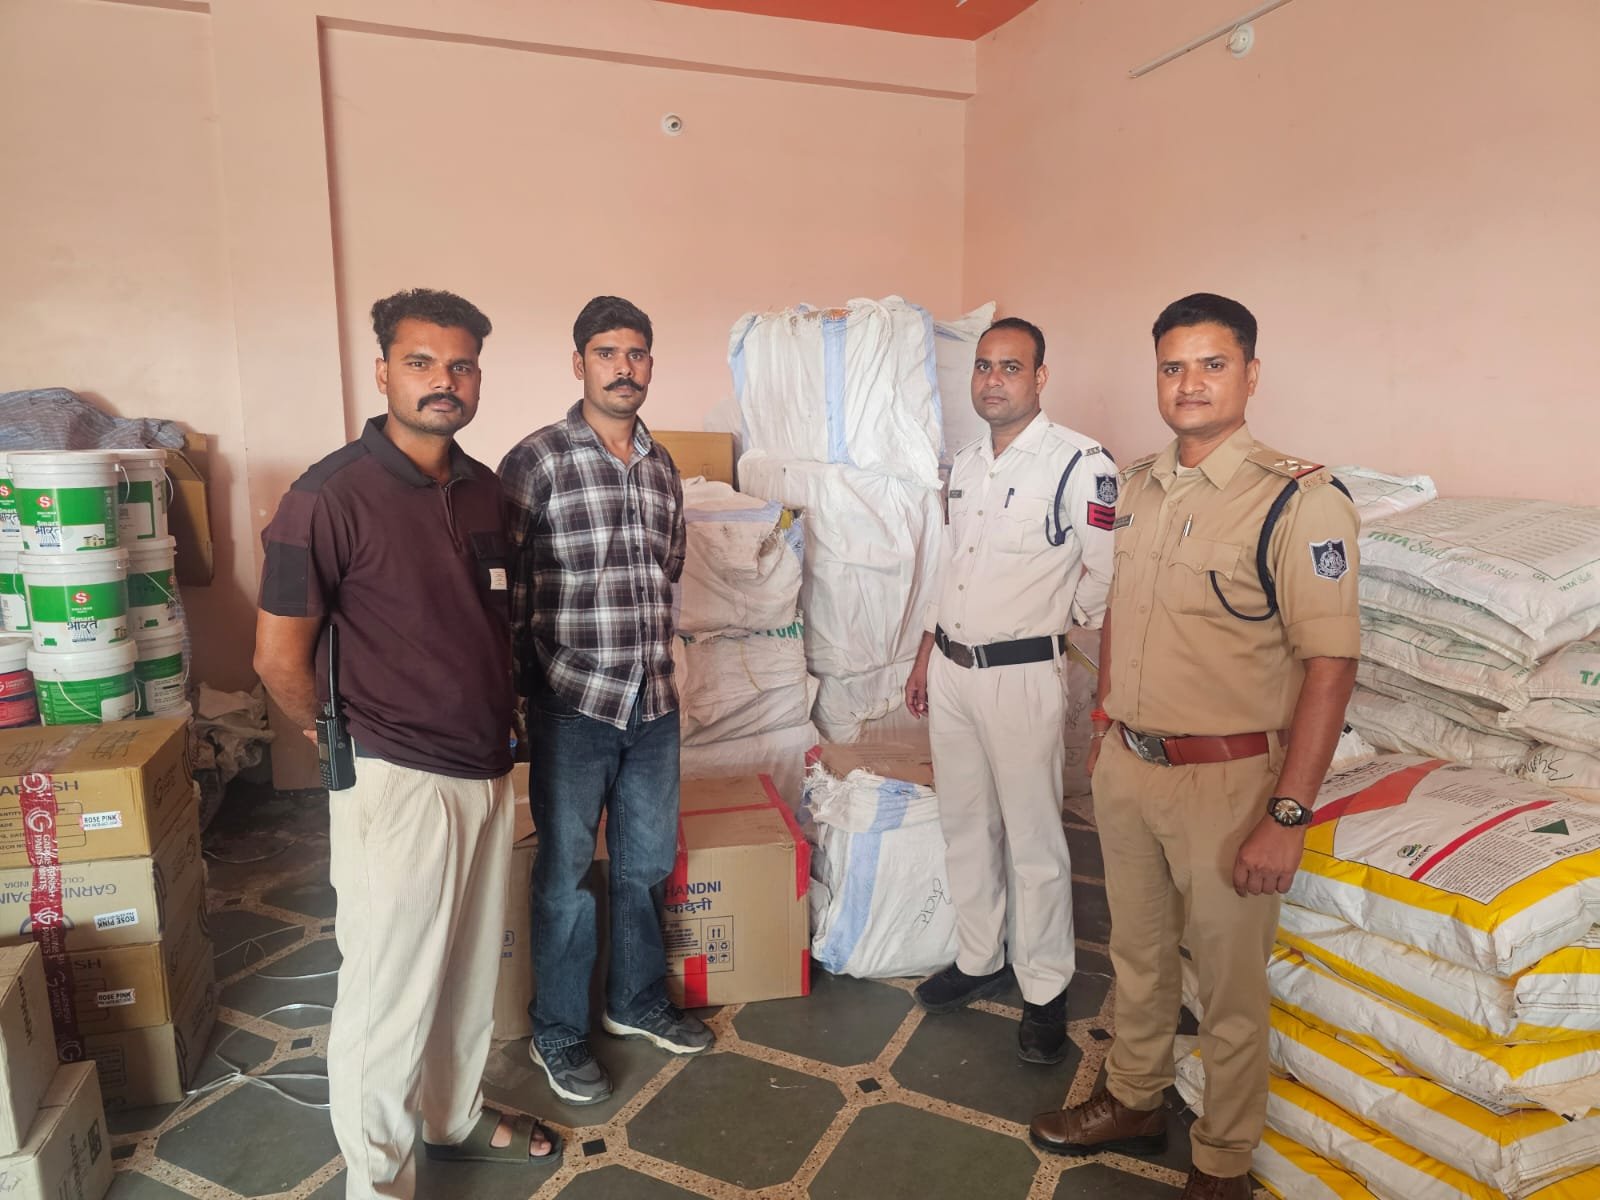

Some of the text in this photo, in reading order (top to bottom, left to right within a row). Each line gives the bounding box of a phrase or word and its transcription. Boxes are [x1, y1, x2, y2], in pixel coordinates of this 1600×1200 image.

[62, 883, 117, 899] GARNI
[97, 918, 115, 929] PINK
[115, 914, 136, 926] ROSE
